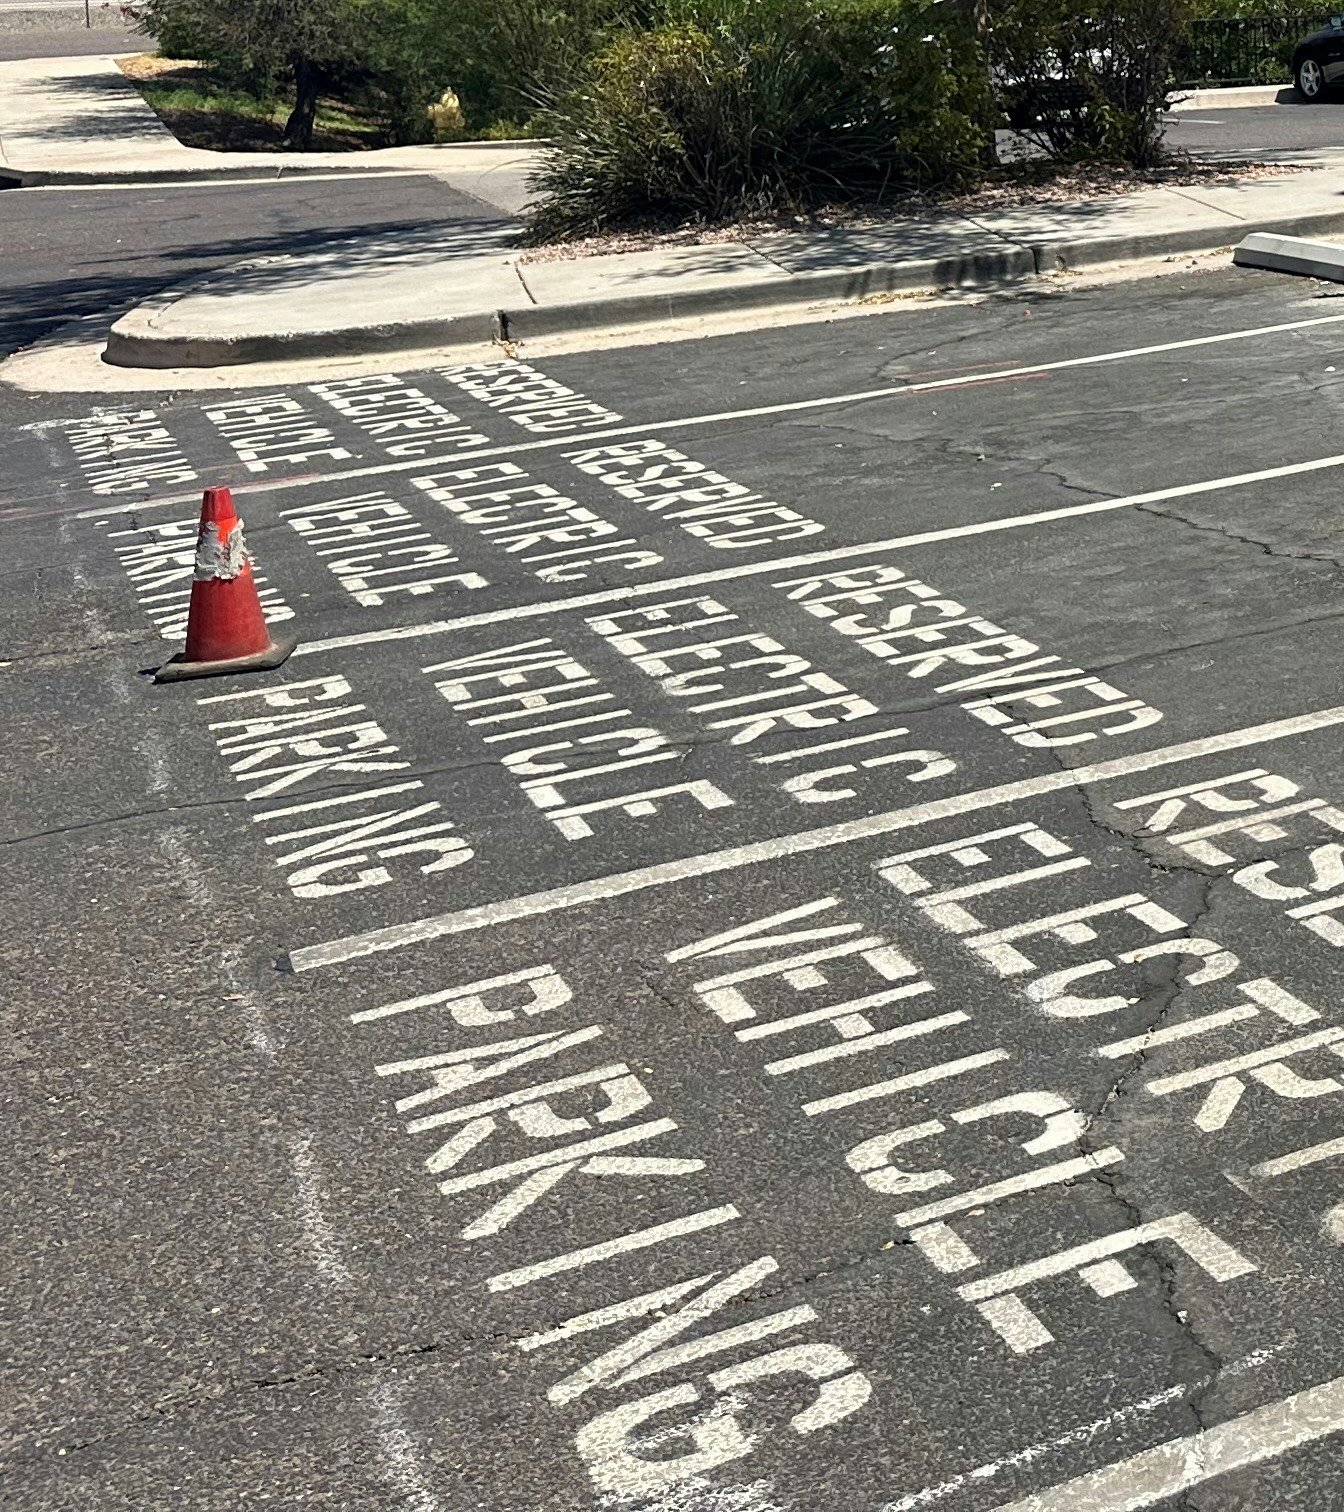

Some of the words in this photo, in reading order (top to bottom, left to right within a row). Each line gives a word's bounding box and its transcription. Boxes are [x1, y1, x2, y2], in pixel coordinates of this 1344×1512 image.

[62, 410, 198, 496] PARKING
[201, 393, 354, 473] VEHICLE
[308, 373, 490, 458] ELECTRIC
[434, 359, 624, 433] RESERVED
[279, 490, 489, 607] VEHICLE
[410, 462, 664, 583] ELECTRIC
[560, 439, 825, 548] RESERVED
[584, 595, 957, 806] ELECTRIC
[771, 564, 1164, 748] RESERVED
[197, 674, 475, 899] PARKING
[422, 638, 736, 842] VEHICLE
[664, 894, 1257, 1355] VEHICLE
[350, 963, 873, 1498] PARKING
